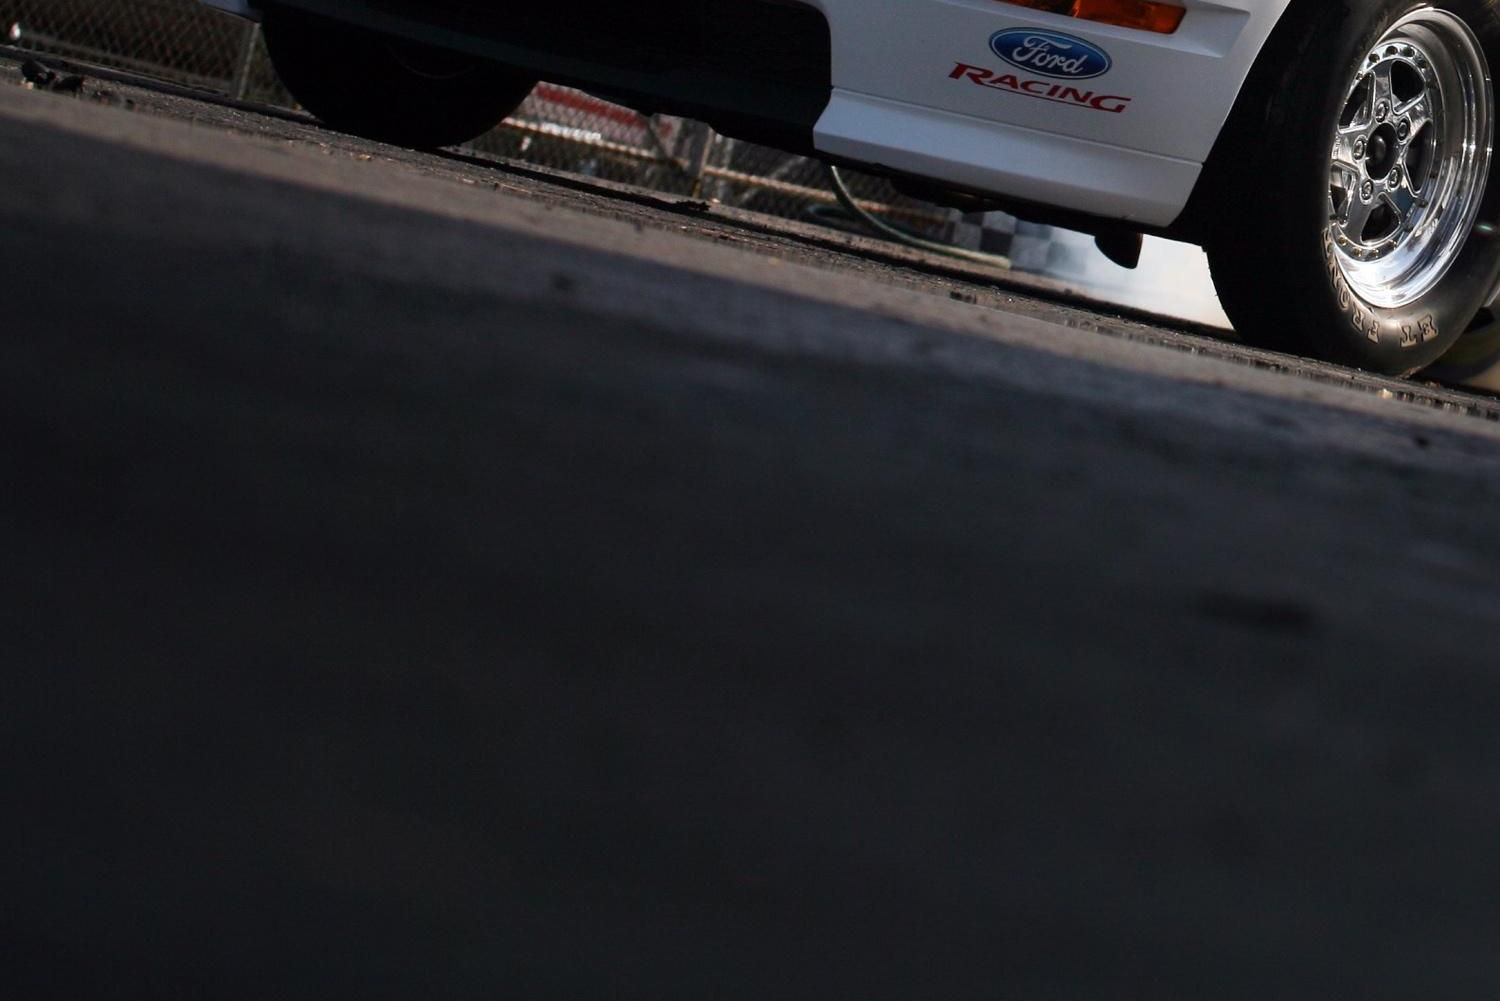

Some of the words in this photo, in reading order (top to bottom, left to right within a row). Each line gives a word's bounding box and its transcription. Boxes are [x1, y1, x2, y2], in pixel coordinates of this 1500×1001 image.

[1012, 34, 1089, 75] Ford
[948, 61, 1132, 114] RACING
[1401, 313, 1439, 347] ET
